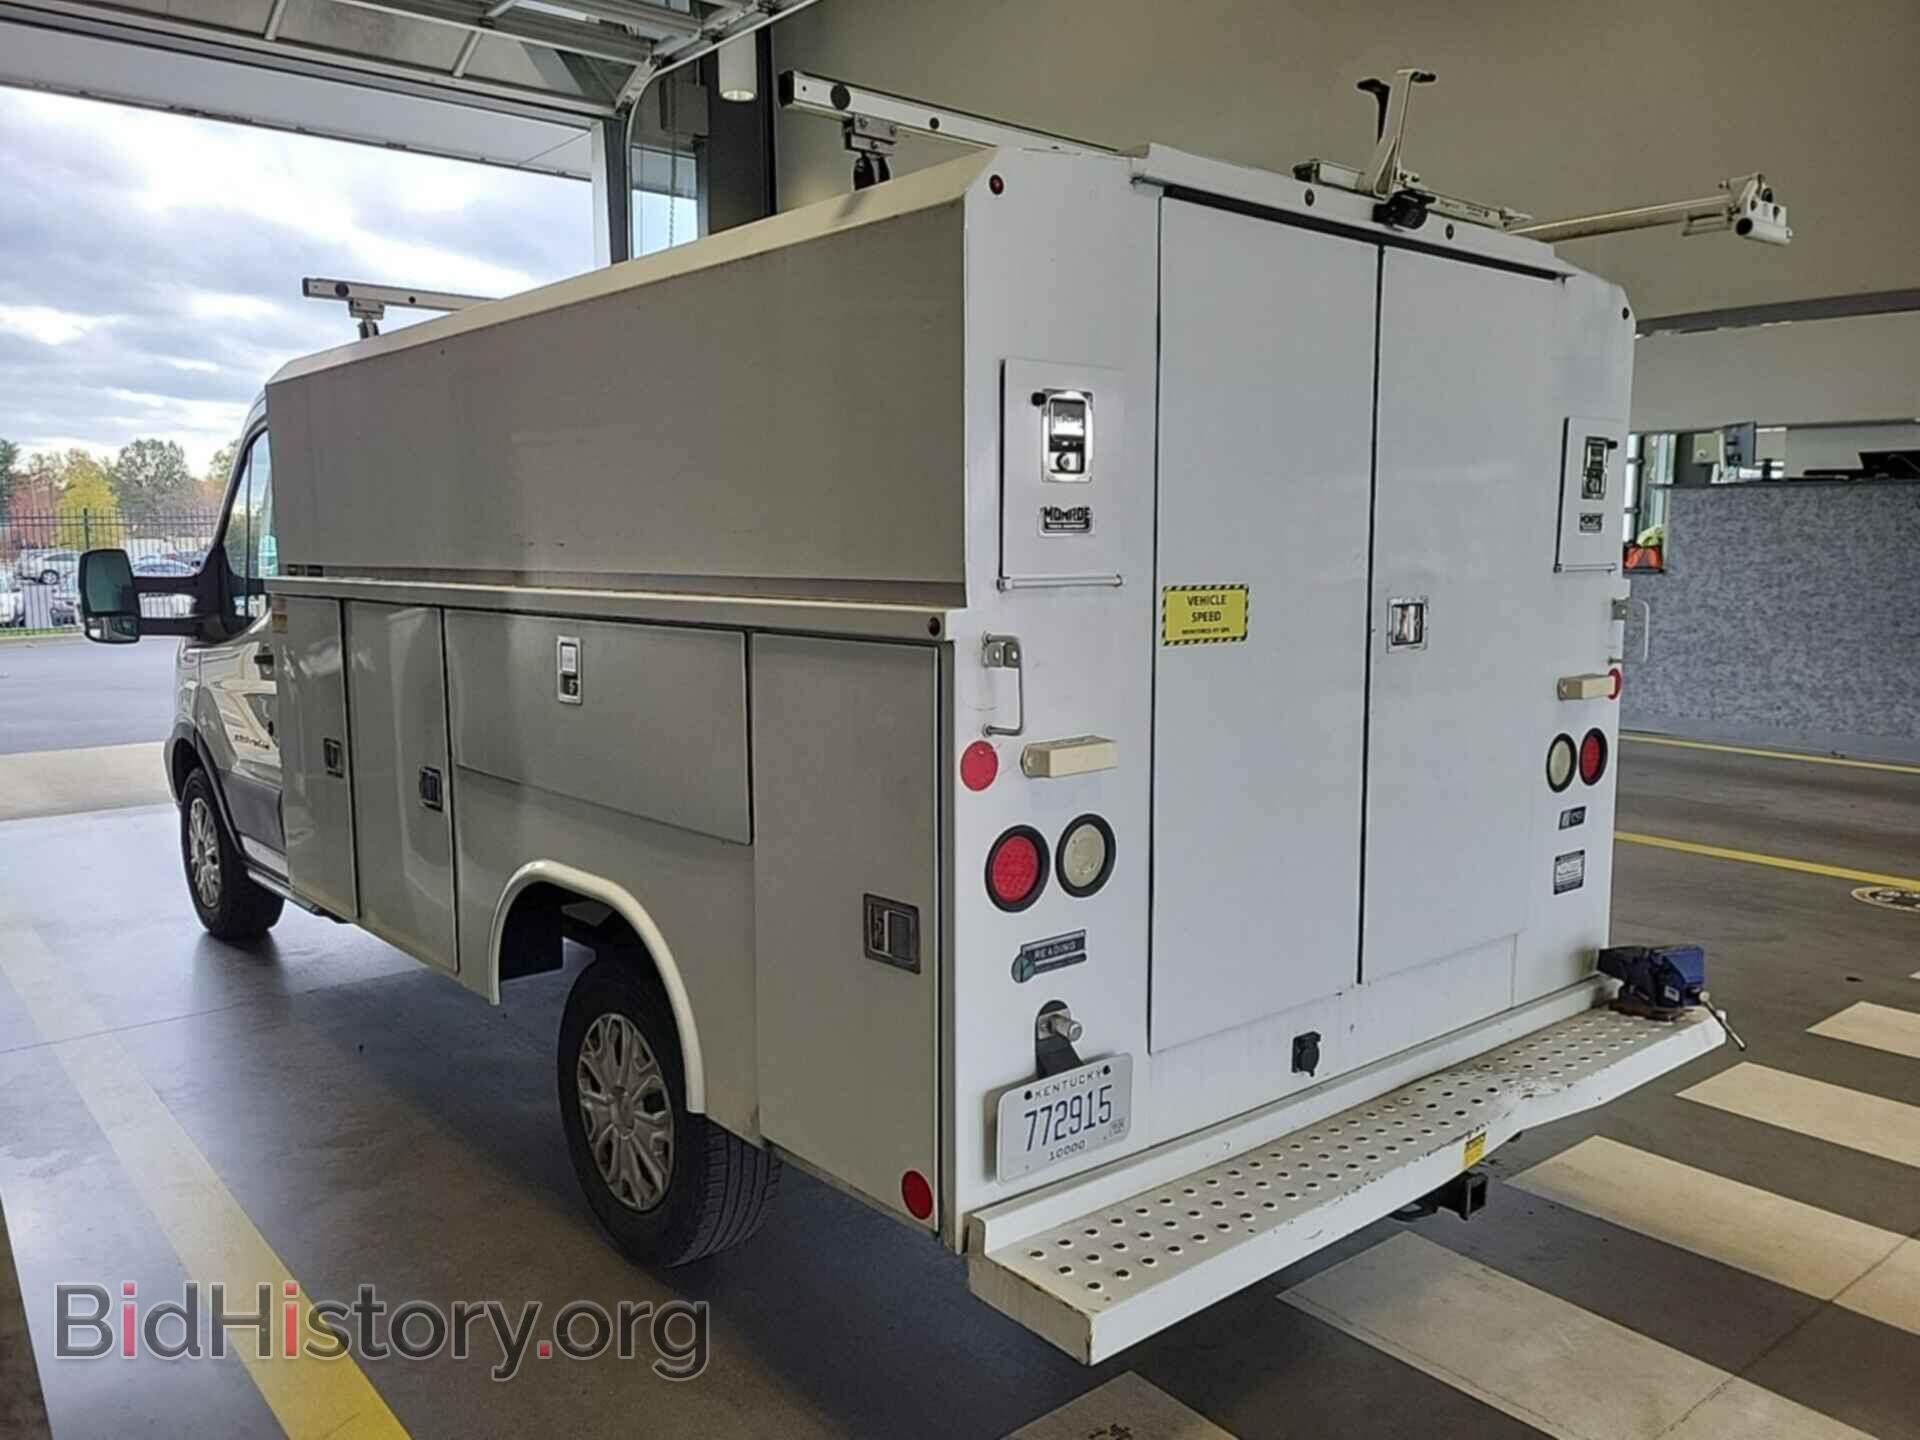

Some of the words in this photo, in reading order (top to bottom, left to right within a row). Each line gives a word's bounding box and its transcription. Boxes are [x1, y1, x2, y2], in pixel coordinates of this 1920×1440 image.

[1187, 595, 1227, 607] VEHICLE
[1191, 610, 1222, 623] SPEED
[1034, 940, 1077, 959] READING
[1034, 1069, 1102, 1099] KENTUCKY
[1024, 1084, 1112, 1151] 772915
[1048, 1139, 1086, 1161] 10000
